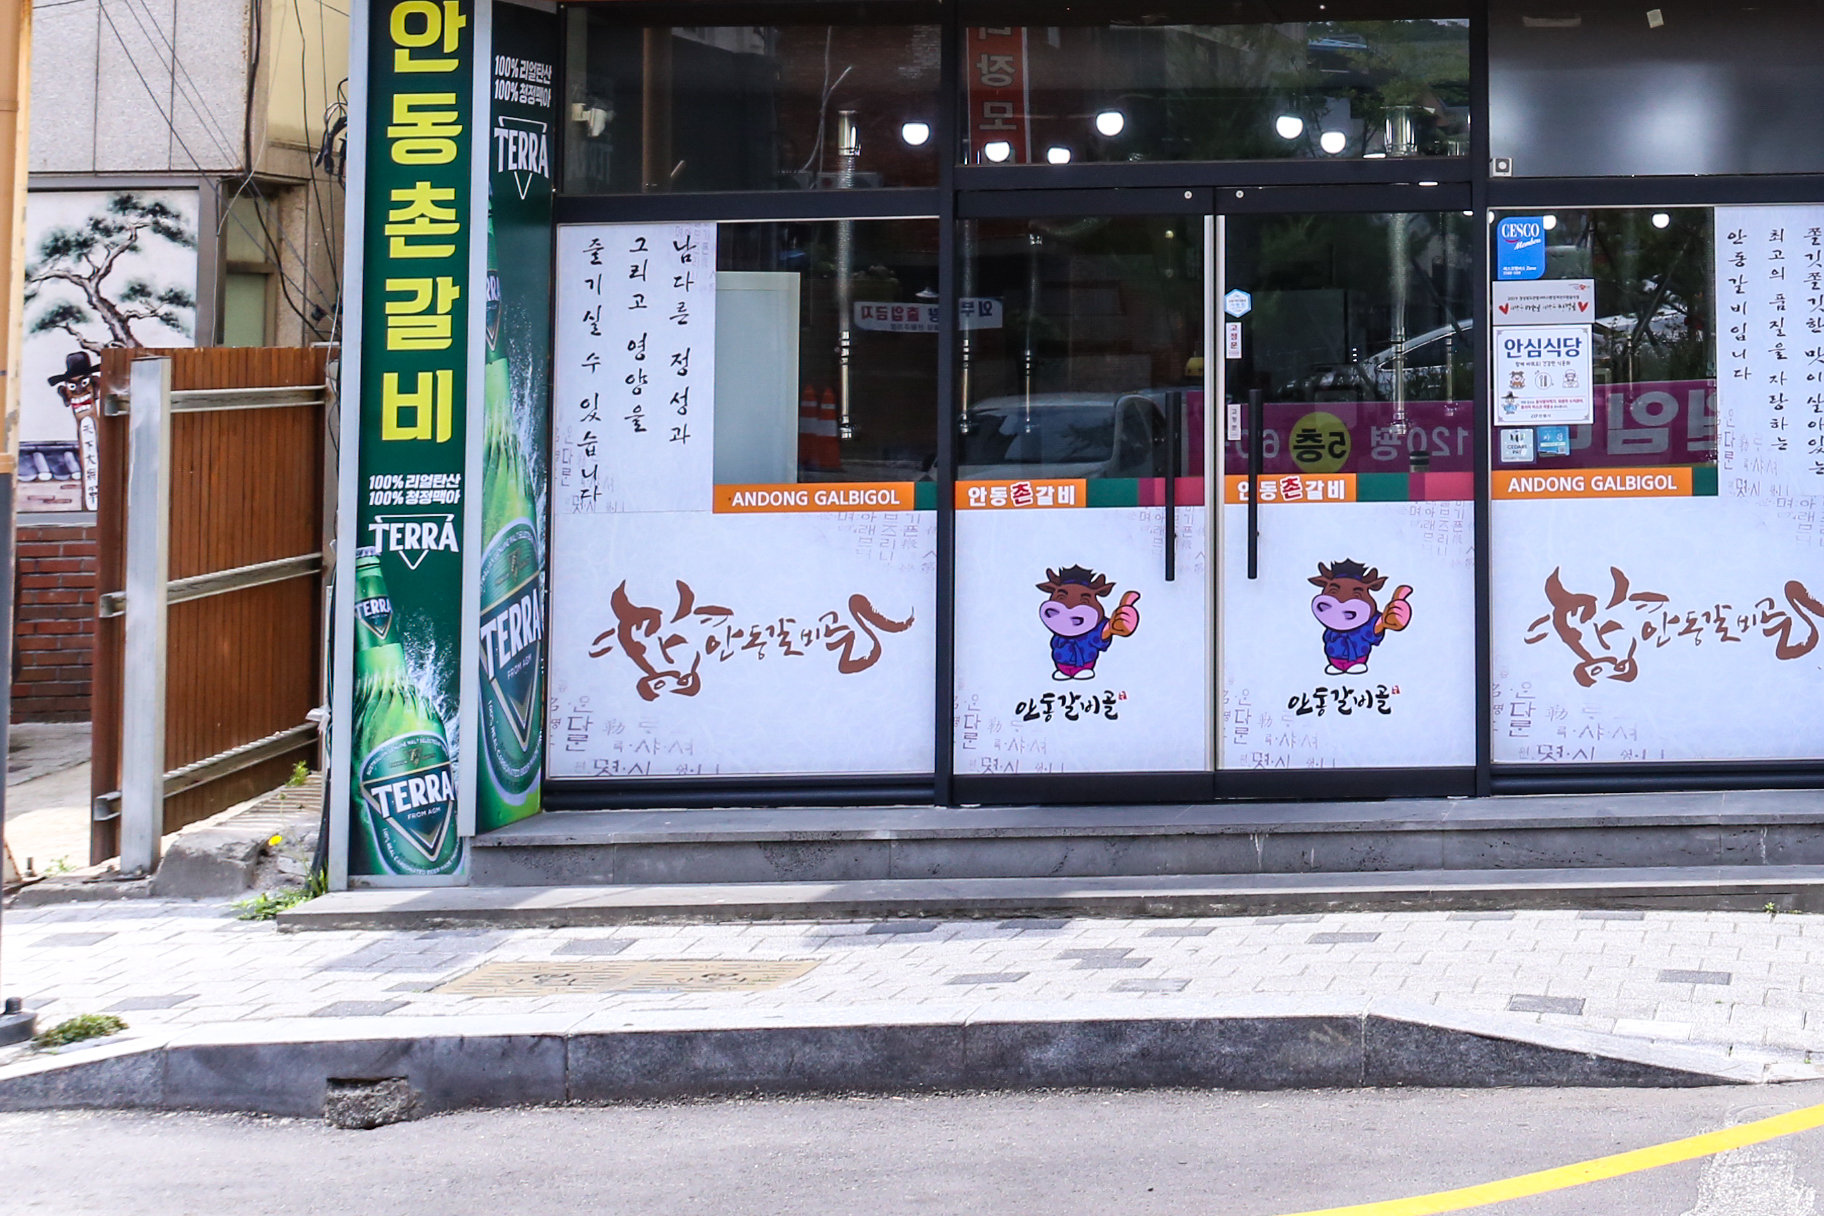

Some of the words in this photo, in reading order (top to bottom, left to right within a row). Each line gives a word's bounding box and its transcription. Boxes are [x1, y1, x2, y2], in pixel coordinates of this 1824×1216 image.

[494, 54, 518, 81] 100%
[519, 56, 552, 85] 리얼탄산
[494, 78, 518, 103] 100%
[519, 82, 552, 108] 청정맥아
[494, 125, 549, 179] TERRA
[380, 0, 467, 444] 안동촌갈비
[1501, 223, 1540, 237] CESCO
[1768, 227, 1786, 281] 최고의
[583, 238, 605, 336] 즐기실
[628, 237, 648, 310] 그리고
[669, 235, 696, 325] 남다른
[1768, 292, 1788, 360] 품질을
[581, 352, 602, 374] 수
[1504, 337, 1582, 359] 안심식당
[624, 332, 648, 433] 영양을
[669, 347, 691, 445] 정성과
[1769, 371, 1789, 451] 자랑하는
[368, 474, 404, 492] 100%
[404, 472, 460, 490] 리얼탄산
[368, 490, 404, 507] 100%
[404, 489, 460, 506] 청정맥아
[732, 490, 808, 507] ANDONG
[814, 489, 901, 506] GALBIGOL
[967, 481, 1076, 507] 안동촌갈비
[1508, 476, 1585, 492] ANDONG
[1590, 474, 1678, 491] GALBIGOL
[368, 521, 459, 553] TERRA
[355, 598, 392, 617] TERRA
[480, 587, 542, 681] TERRA
[1015, 689, 1119, 721] 안동갈비골
[1288, 684, 1391, 716] 안동갈비골
[371, 770, 455, 819] TERRA
